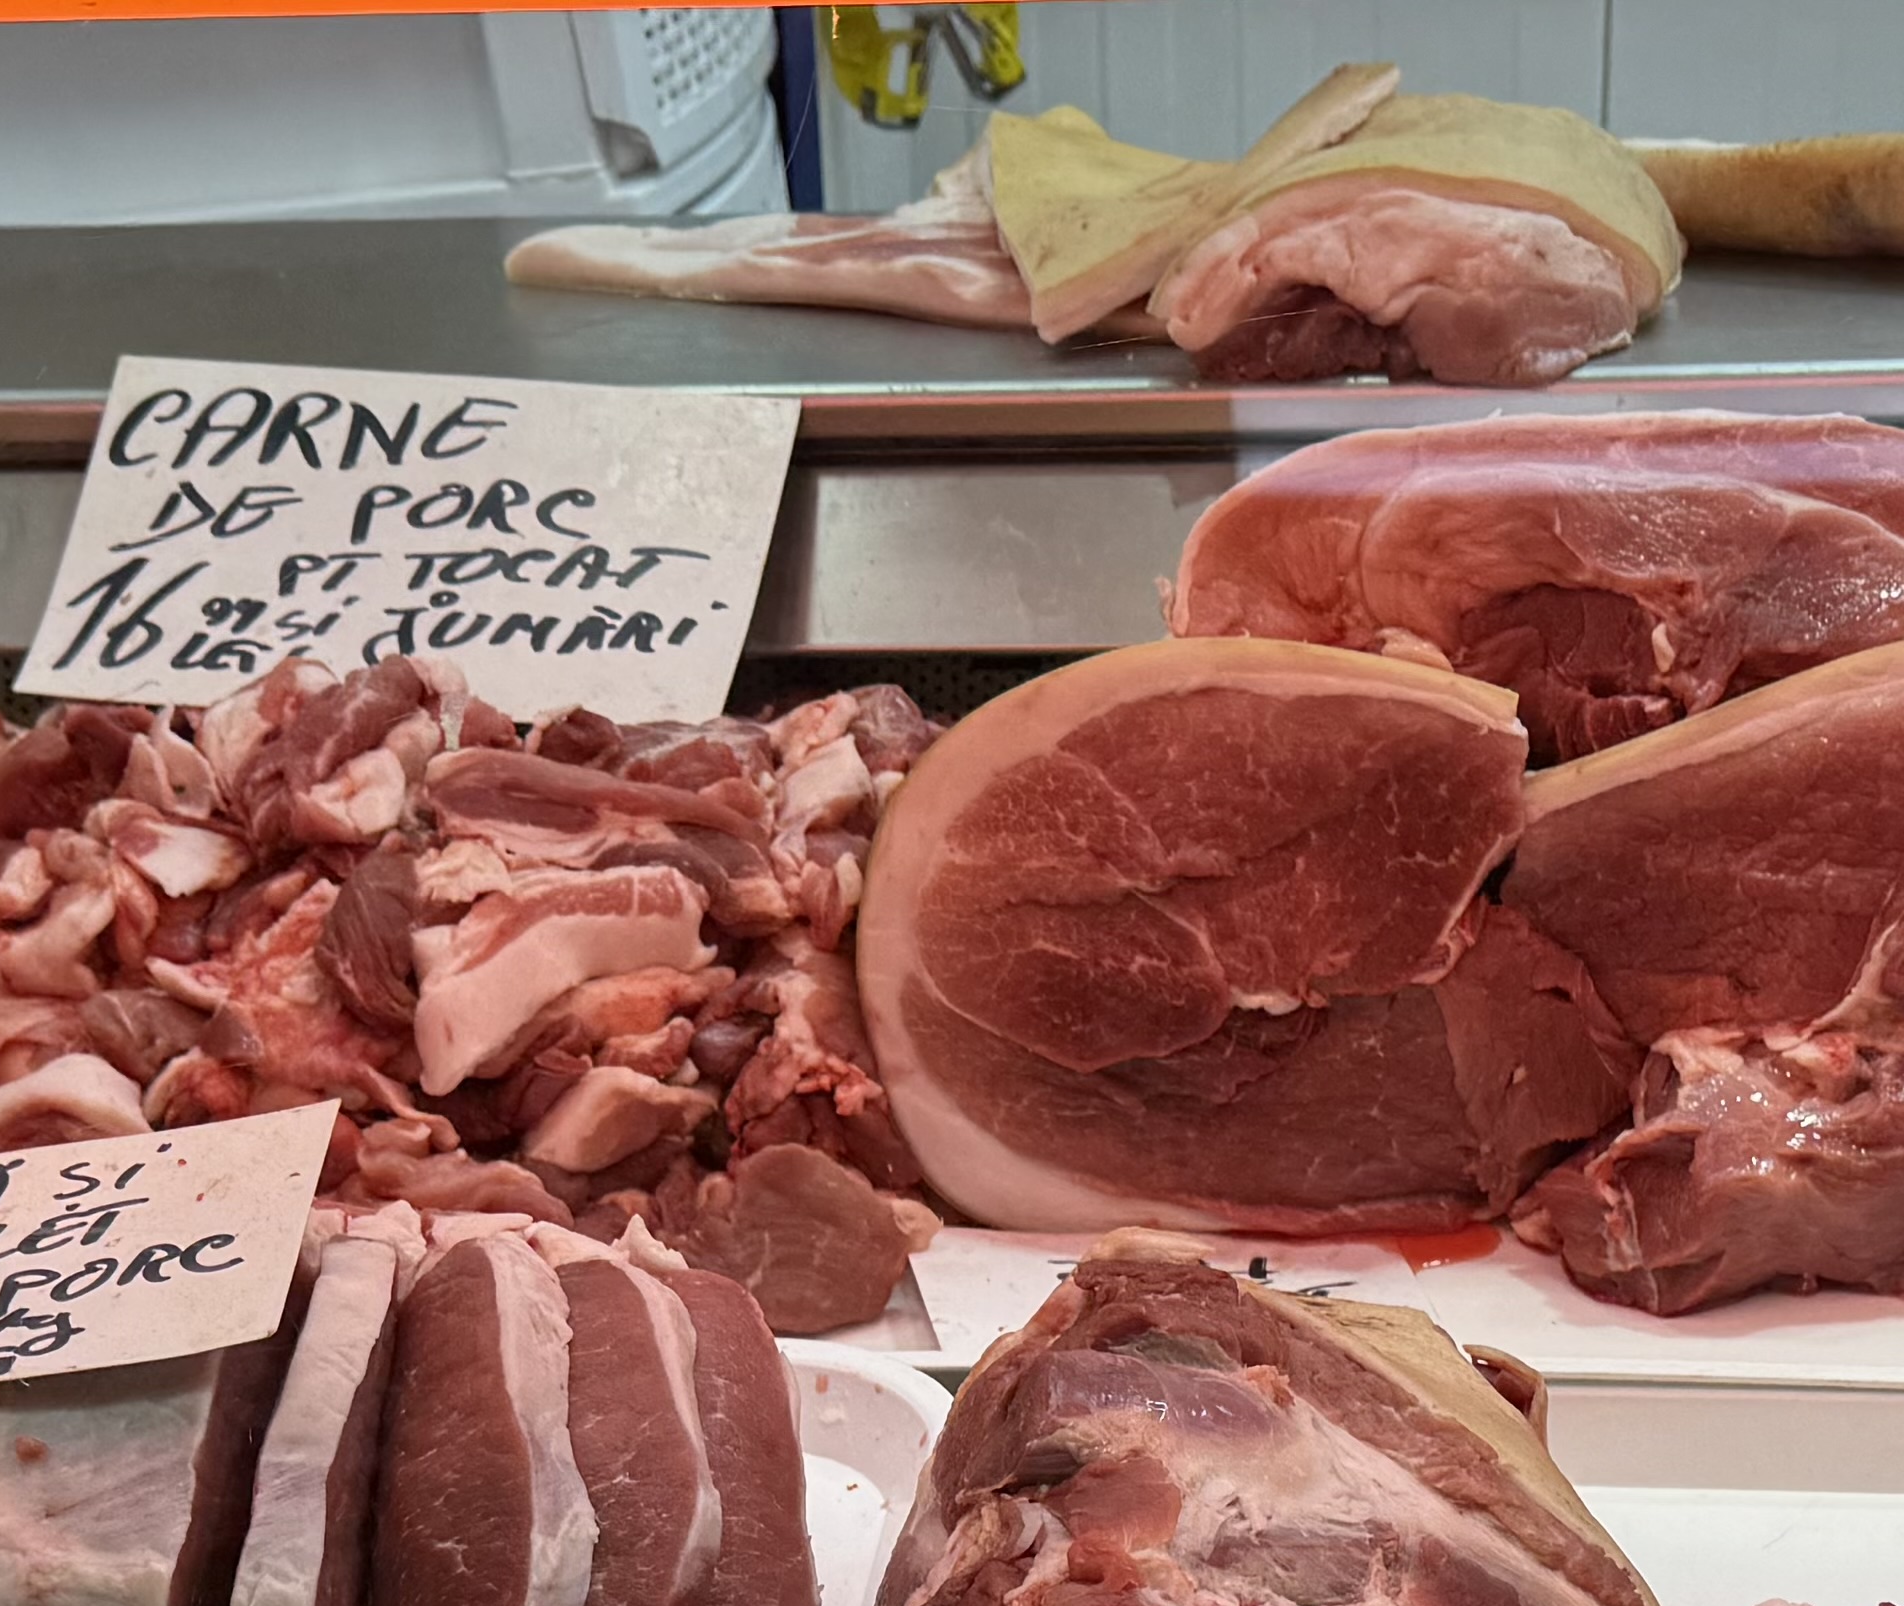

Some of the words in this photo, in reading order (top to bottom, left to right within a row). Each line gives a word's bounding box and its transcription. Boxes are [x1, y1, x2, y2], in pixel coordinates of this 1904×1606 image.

[108, 387, 519, 470] CARNE
[109, 482, 302, 551] DE
[350, 479, 596, 544] PORC
[278, 552, 382, 598] PT
[405, 545, 711, 591] TOCAT
[52, 556, 211, 671] 16
[201, 597, 267, 634] 99
